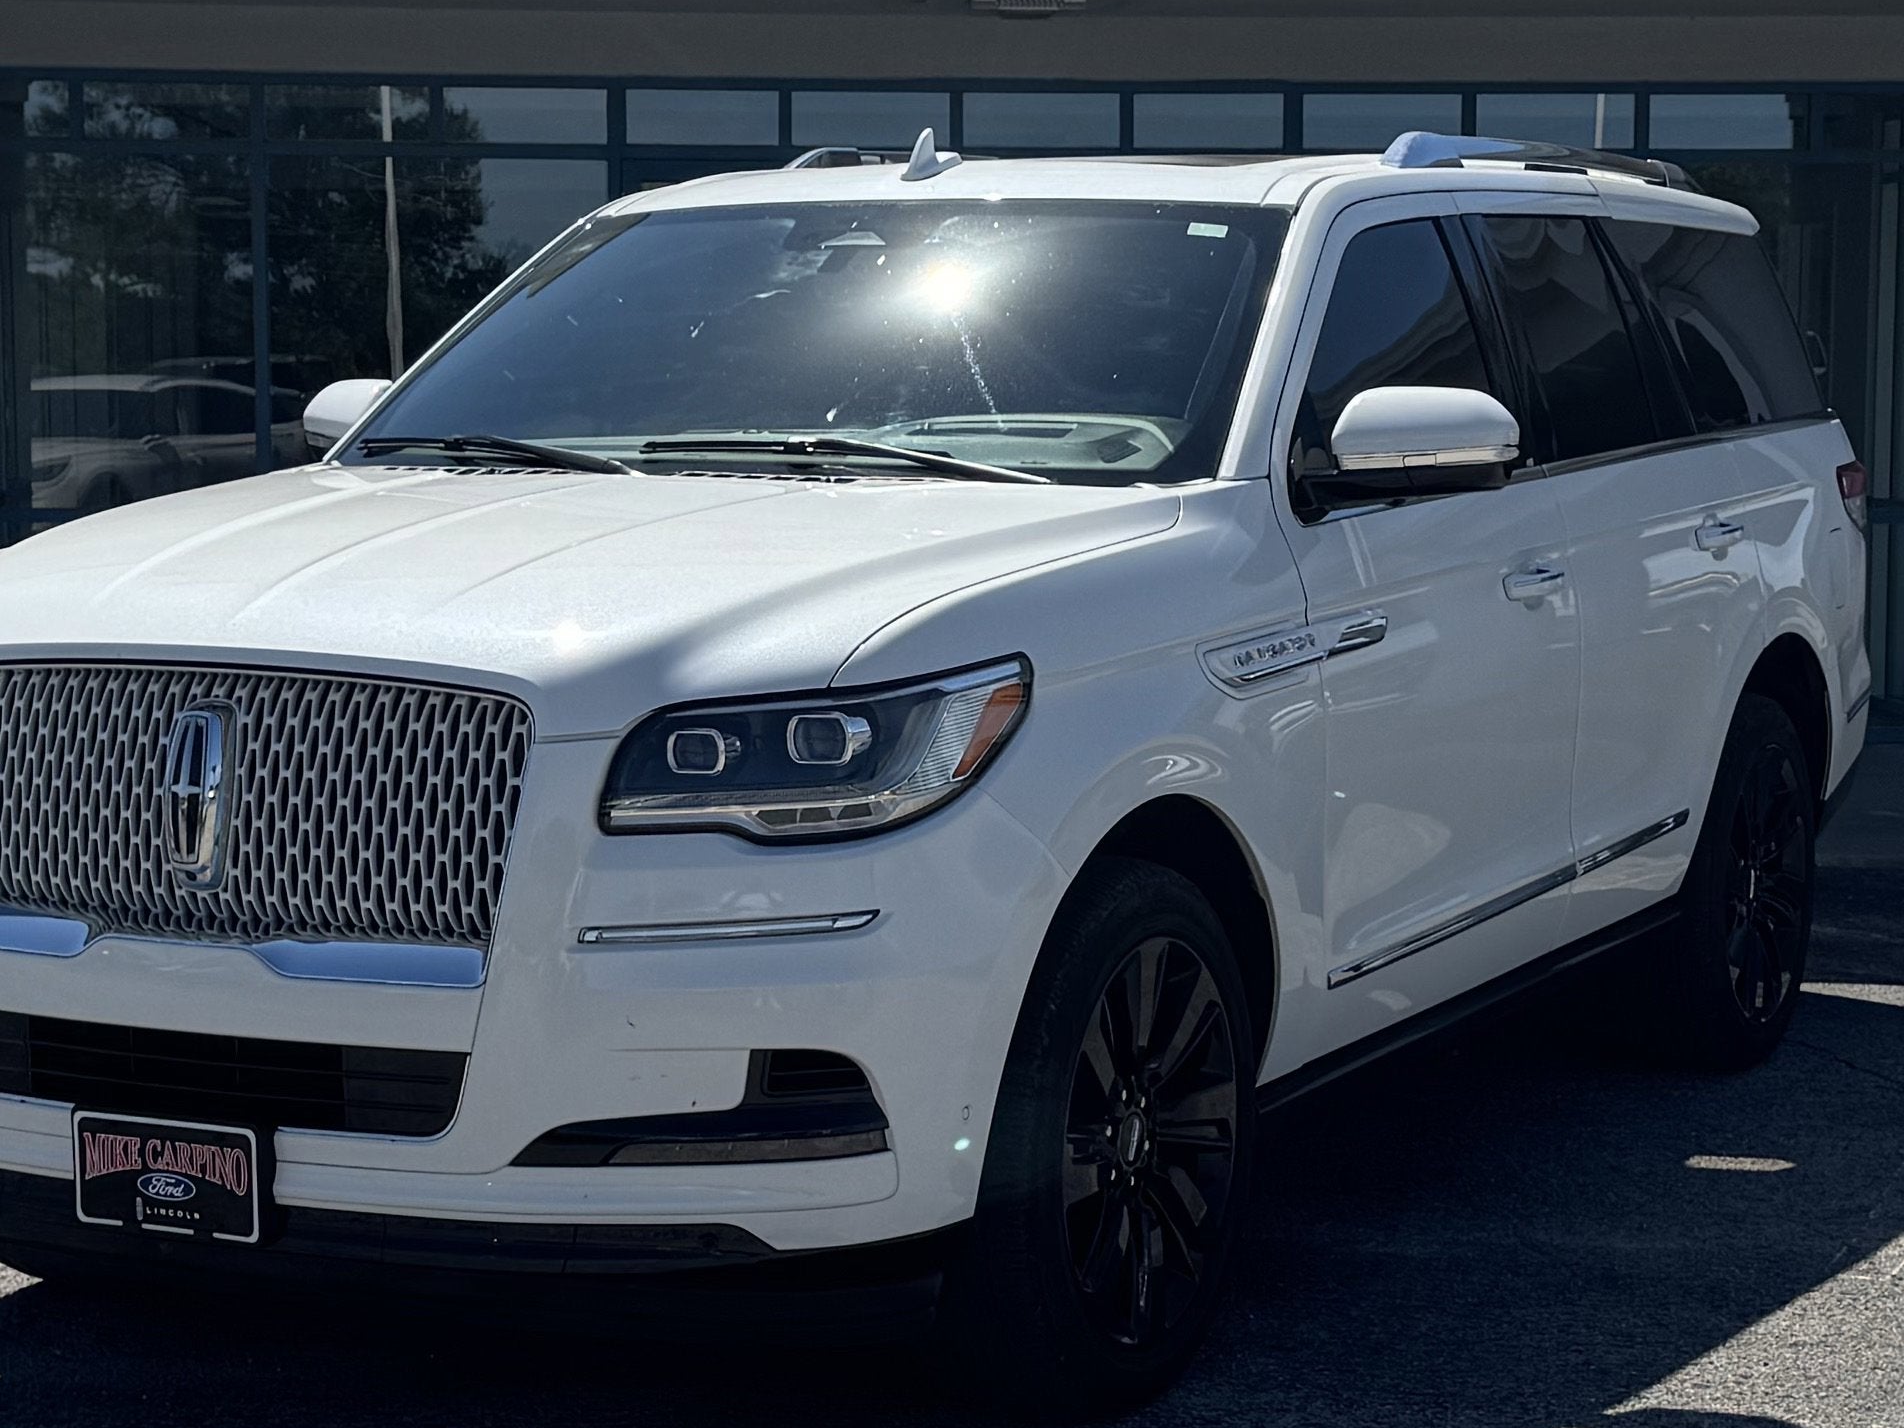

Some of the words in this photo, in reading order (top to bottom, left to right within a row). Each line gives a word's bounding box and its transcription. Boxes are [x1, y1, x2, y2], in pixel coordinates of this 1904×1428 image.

[84, 1132, 141, 1179] MIKE
[146, 1139, 247, 1195] CARPINO
[148, 1176, 184, 1197] Ford
[146, 1206, 200, 1220] LINCOLN
